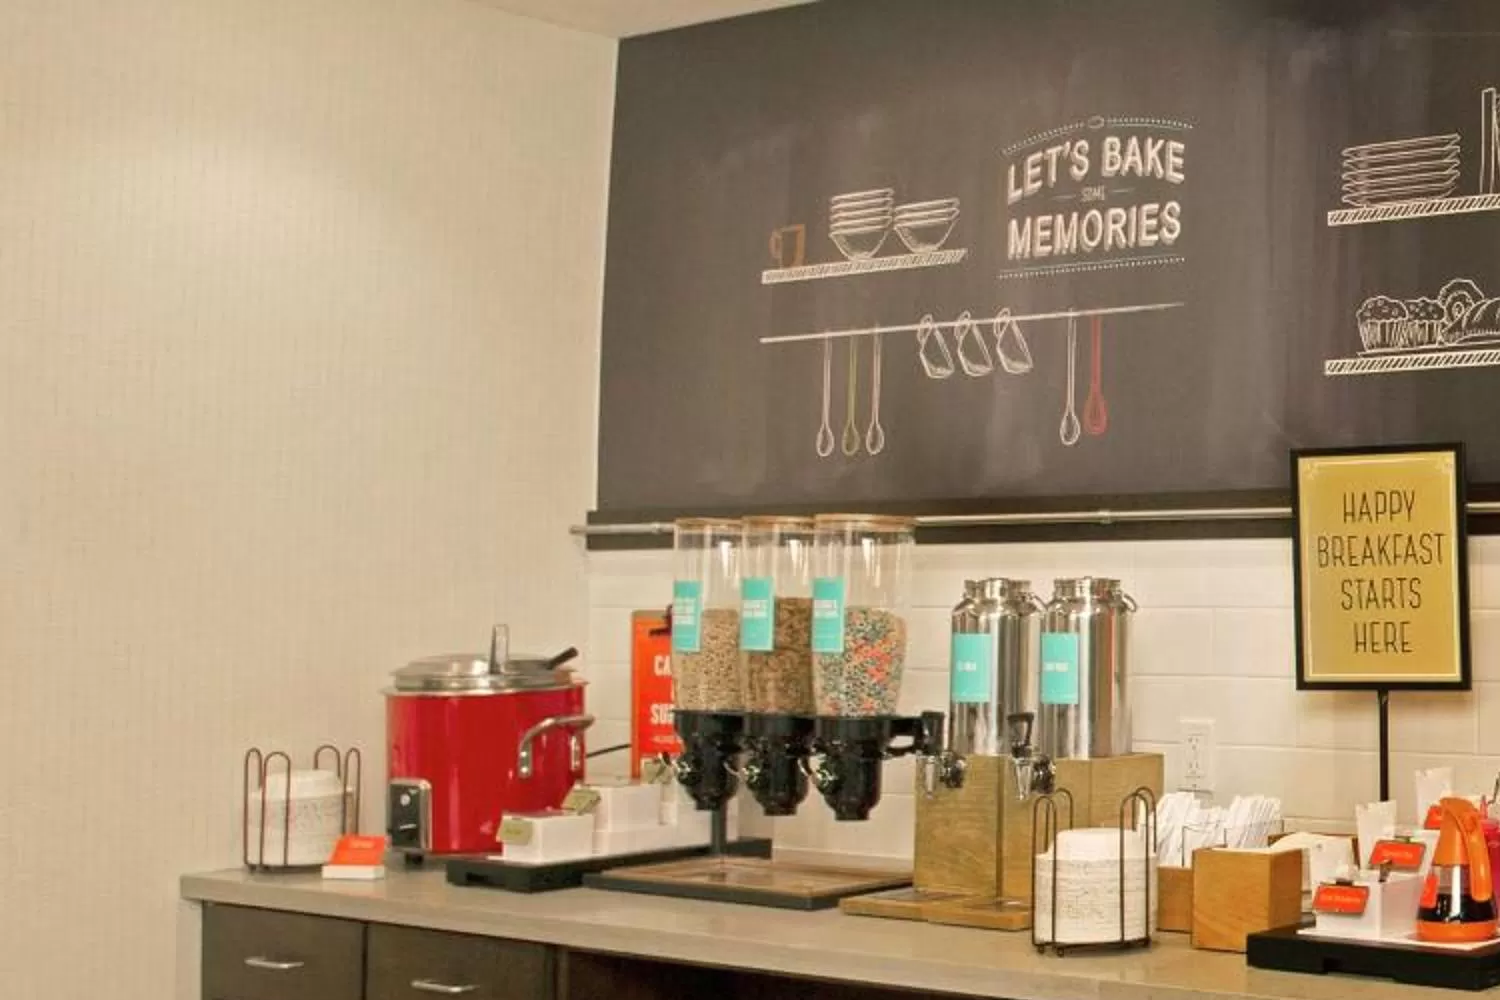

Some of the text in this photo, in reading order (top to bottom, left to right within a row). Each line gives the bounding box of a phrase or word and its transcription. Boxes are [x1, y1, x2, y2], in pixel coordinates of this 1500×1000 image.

[1008, 136, 1185, 204] LET'S BAKE
[1008, 202, 1181, 260] MEMORIES
[1343, 490, 1415, 524] HAPPY
[1317, 533, 1445, 568] BREAKFAST
[1341, 577, 1421, 610] STARTS
[1354, 621, 1414, 653] HERE
